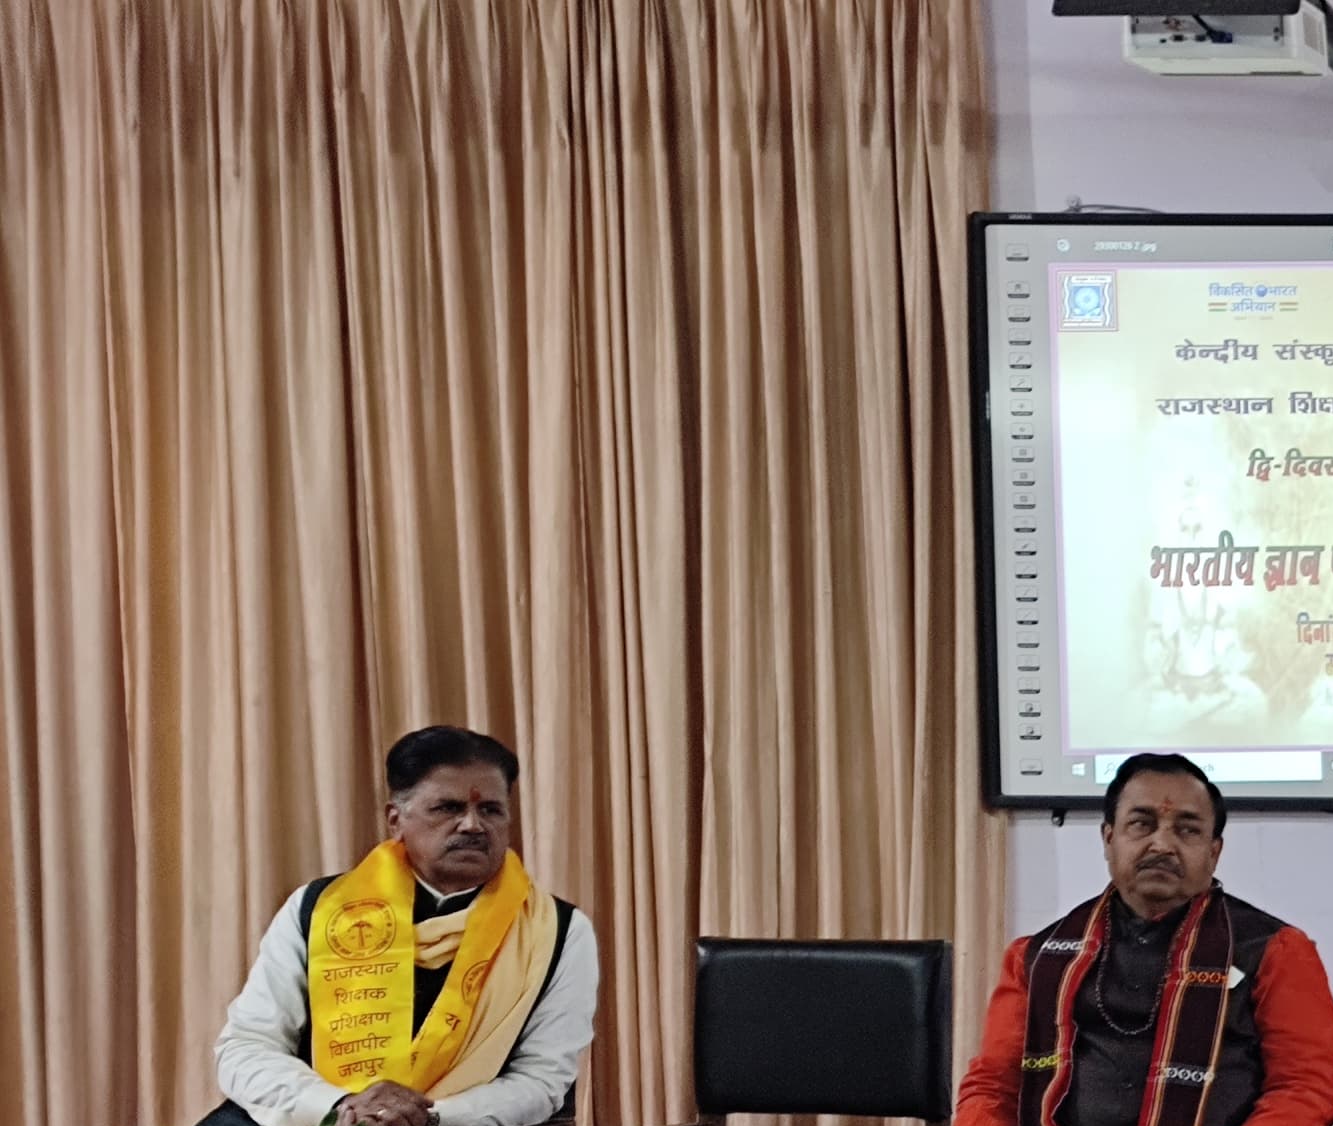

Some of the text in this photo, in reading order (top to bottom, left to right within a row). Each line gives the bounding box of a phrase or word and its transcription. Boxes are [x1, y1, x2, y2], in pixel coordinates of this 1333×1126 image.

[1155, 397, 1273, 415] राजस्थान
[1150, 530, 1259, 588] भारतीय
[1263, 545, 1325, 591] ज्ञान
[322, 962, 400, 983] राजस्थान
[333, 986, 387, 1006] शिक्षक
[329, 1011, 391, 1033] प्रशिक्षण
[338, 1056, 385, 1079] जयपुर
